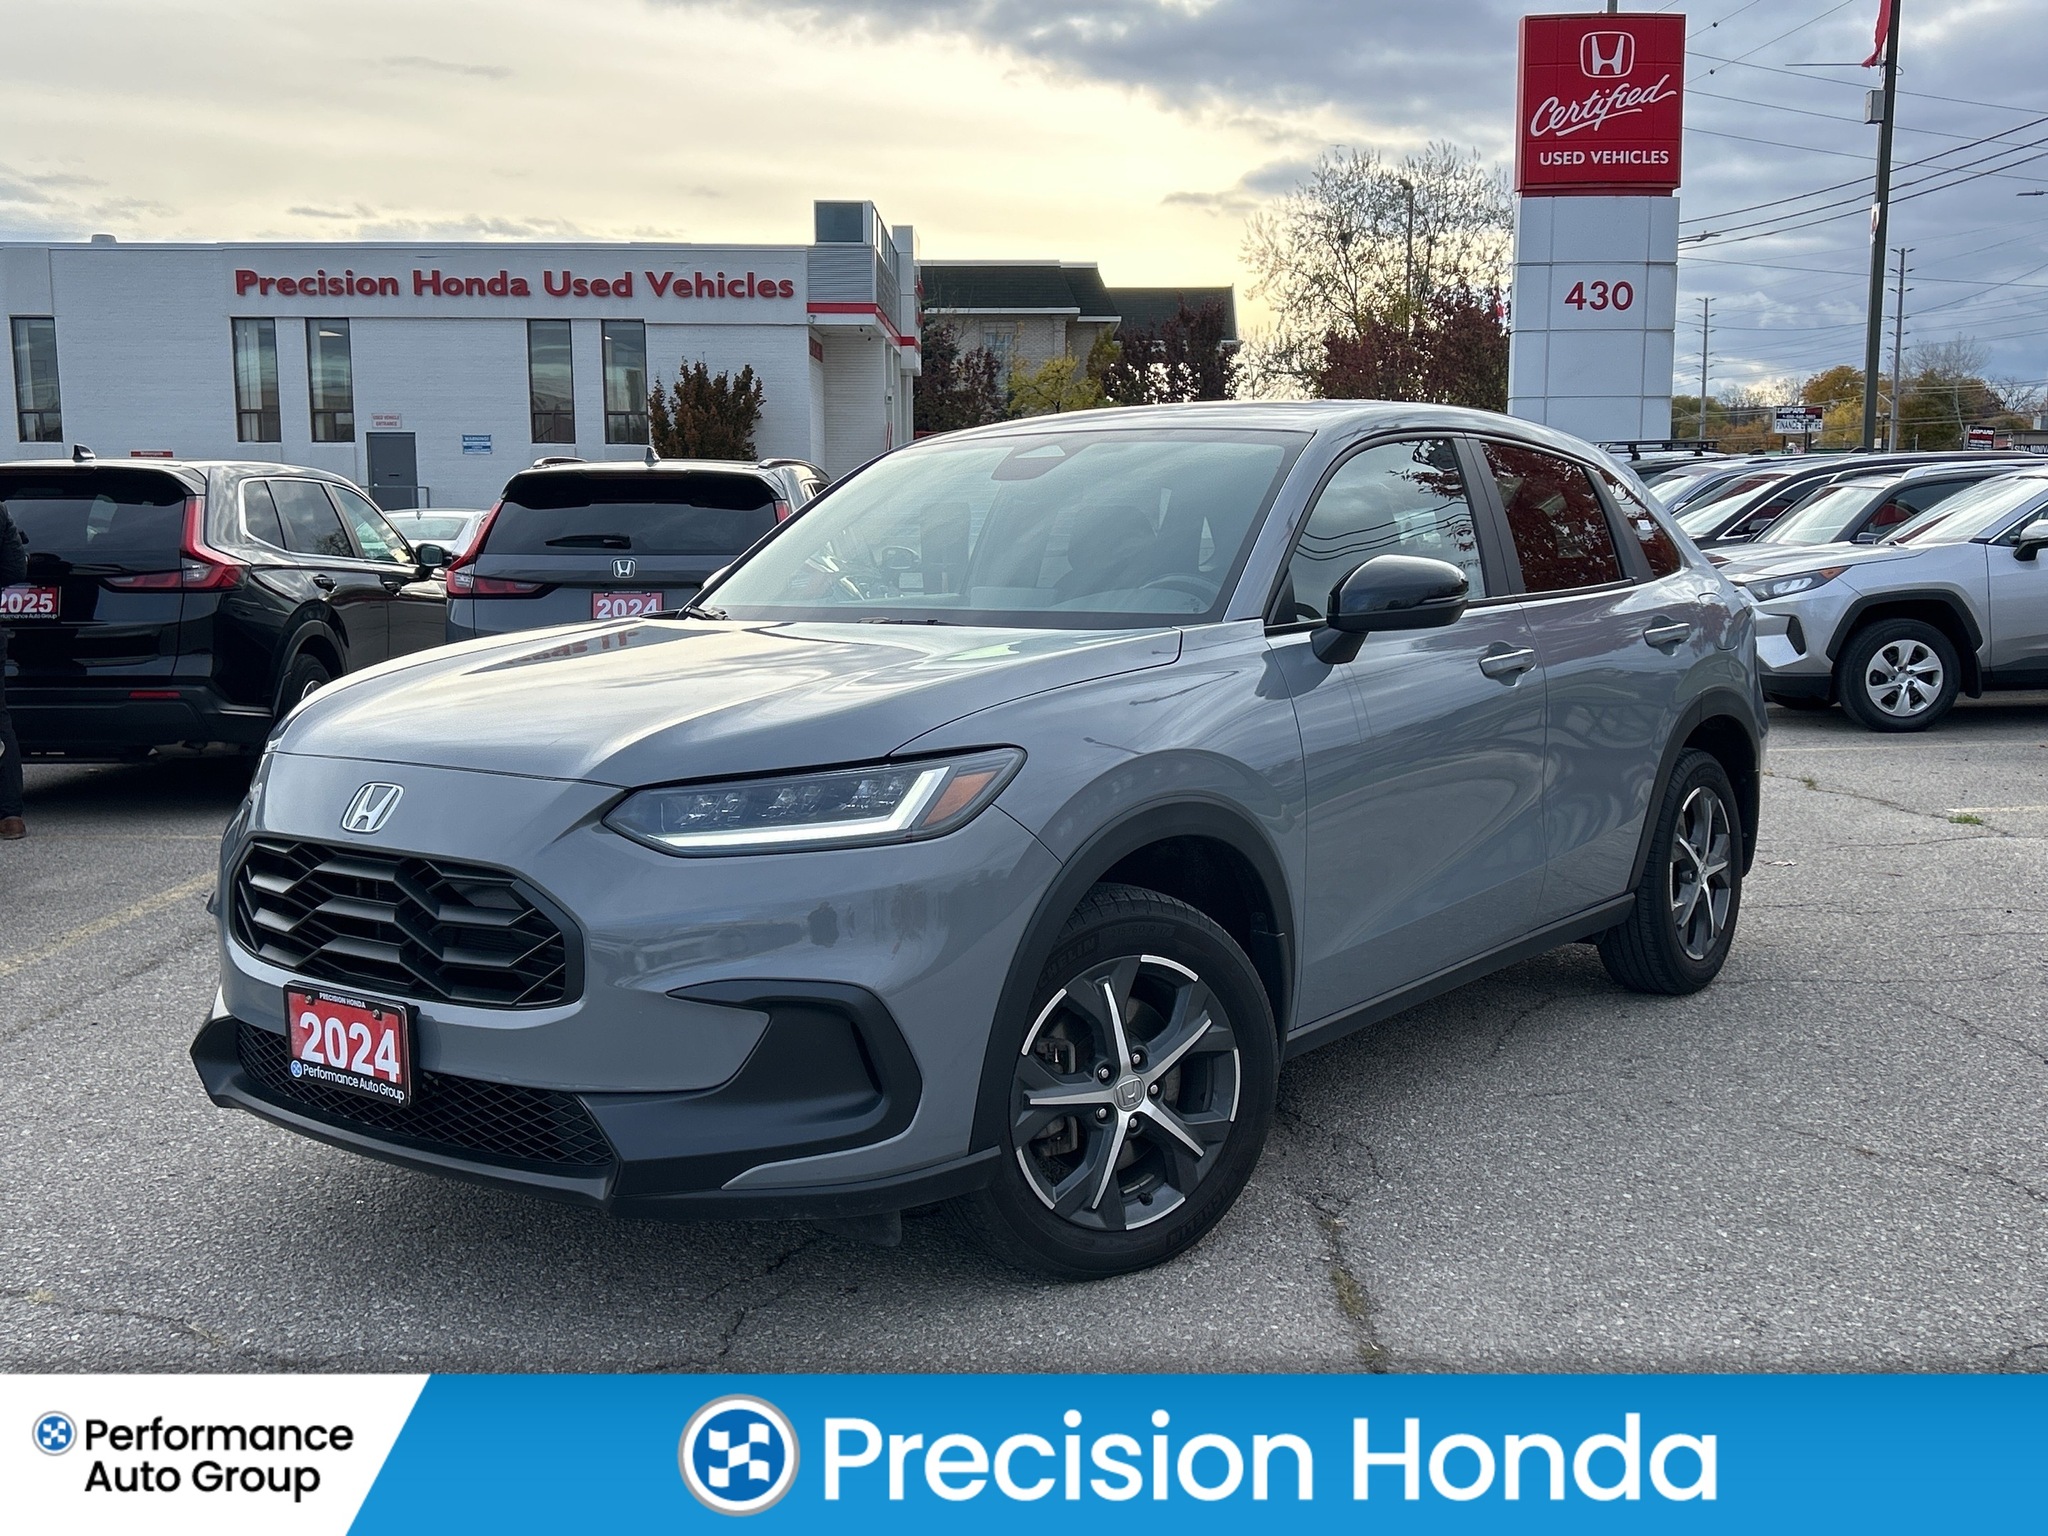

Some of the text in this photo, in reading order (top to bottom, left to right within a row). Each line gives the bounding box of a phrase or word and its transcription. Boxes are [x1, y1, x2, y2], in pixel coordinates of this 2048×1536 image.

[1530, 74, 1678, 137] Certified
[1540, 150, 1669, 166] USED VEHICLES
[235, 269, 795, 298] Precision Honda Used Vehicles
[1564, 280, 1634, 311] 430
[596, 598, 657, 619] 2024
[346, 998, 367, 1009] HONDA
[300, 1011, 400, 1083] 2024
[303, 1063, 405, 1104] Performance Auto Group
